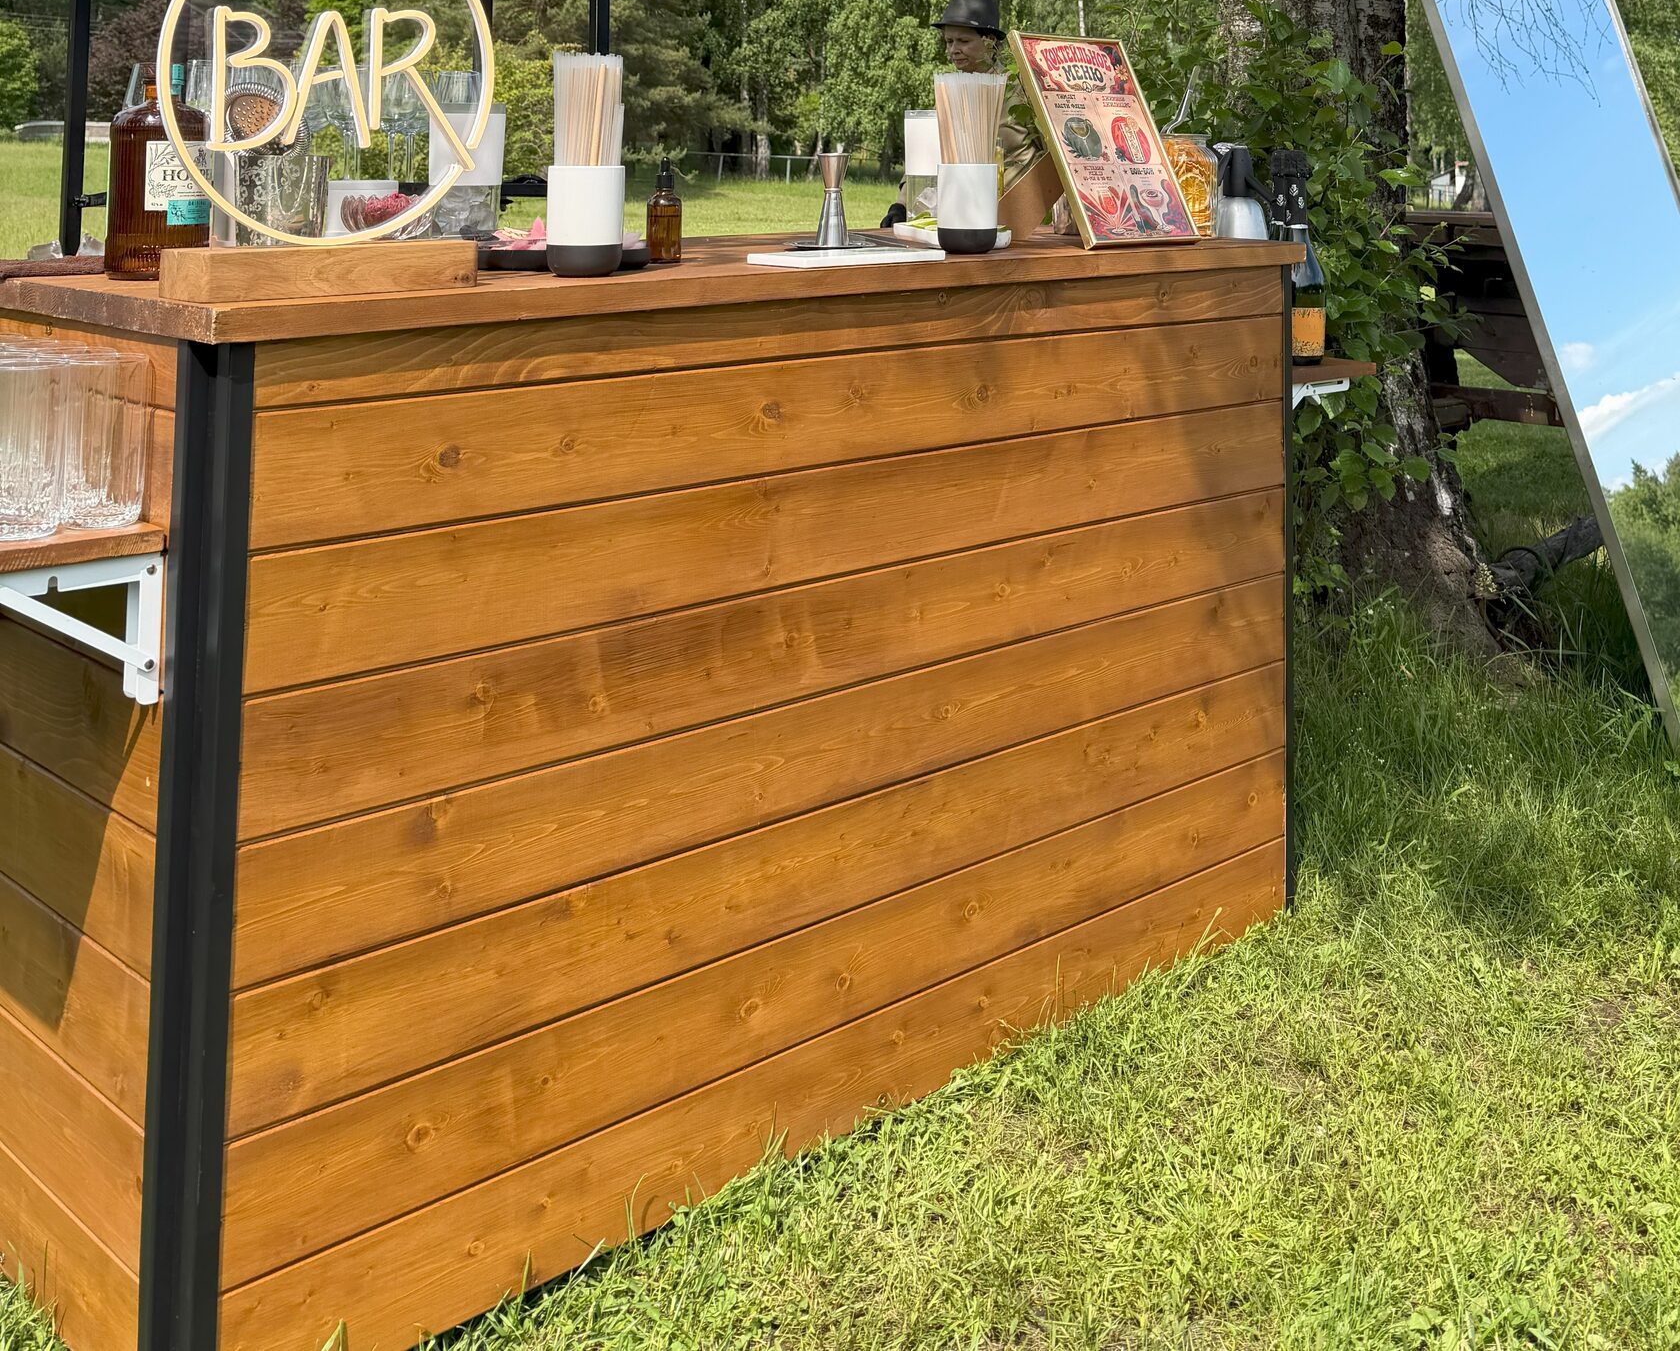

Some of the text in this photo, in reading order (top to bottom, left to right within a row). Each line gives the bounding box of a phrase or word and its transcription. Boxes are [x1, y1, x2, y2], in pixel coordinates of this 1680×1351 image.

[1040, 44, 1112, 72] КОКТЕЙЛЬНОЕ
[1061, 64, 1104, 83] МЕНЮ
[206, 6, 475, 171] BAR
